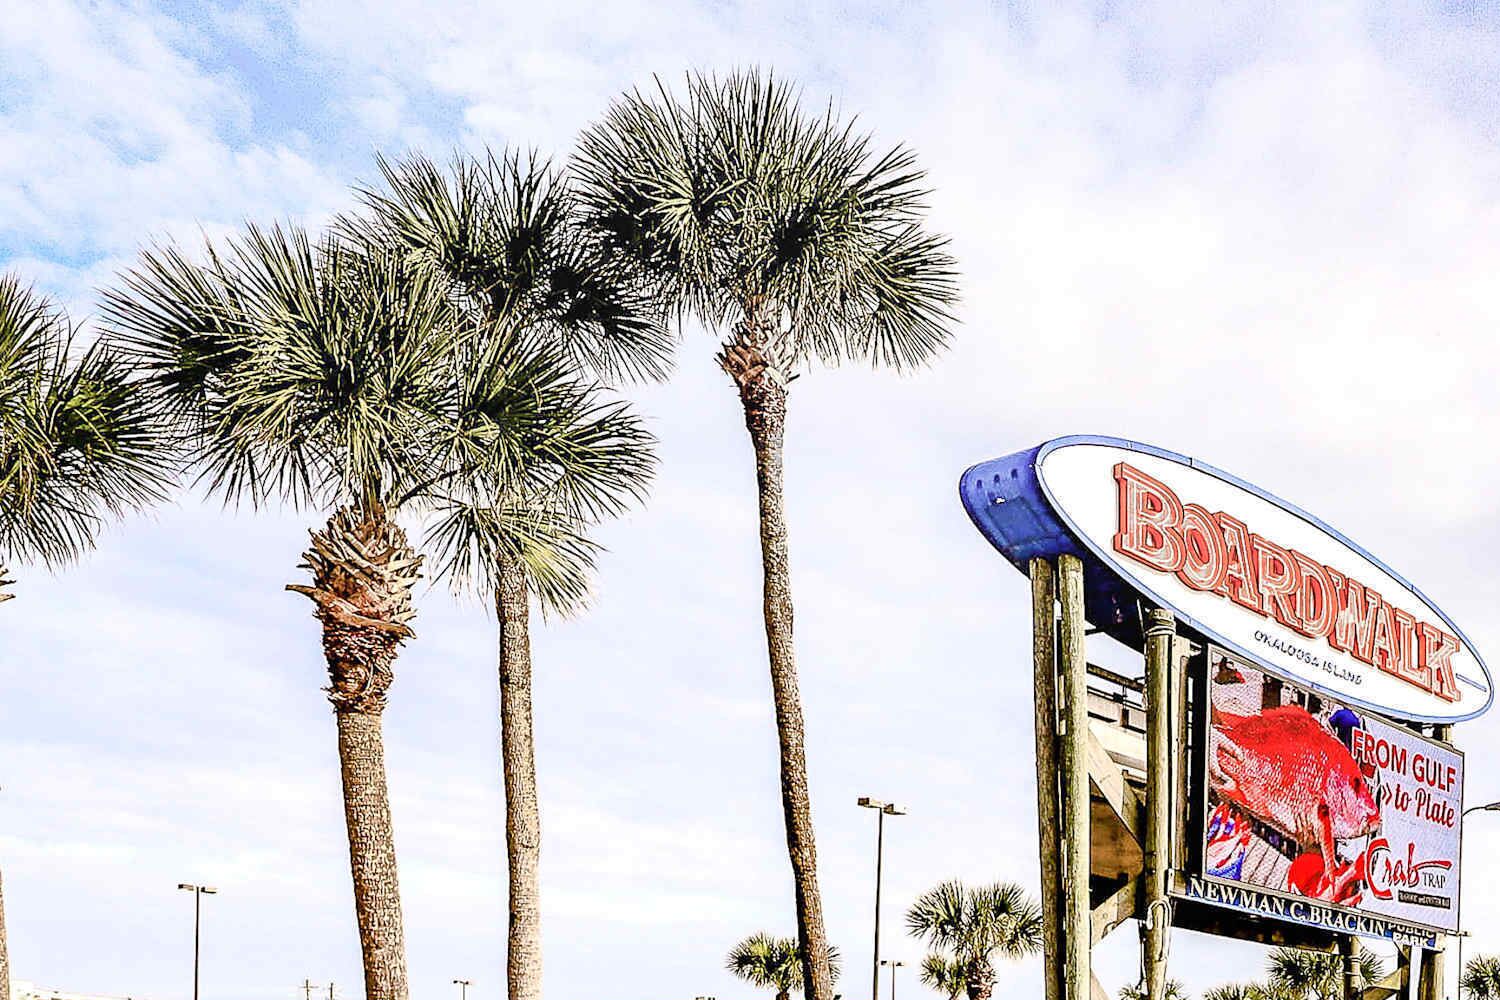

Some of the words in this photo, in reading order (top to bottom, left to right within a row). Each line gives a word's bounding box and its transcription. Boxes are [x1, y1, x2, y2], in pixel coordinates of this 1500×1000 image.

[1112, 461, 1462, 703] BOARDWALK
[1254, 630, 1319, 667] OKALOOSA
[1322, 660, 1362, 685] ISLAND
[1352, 729, 1407, 776] FROM
[1412, 753, 1456, 792] GULF
[1394, 783, 1411, 812] to
[1414, 787, 1455, 828] Plate
[1366, 838, 1452, 900] Crab
[1422, 871, 1447, 889] TRAP
[1189, 877, 1285, 915] NEWMAN
[1289, 901, 1306, 923] C.
[1309, 905, 1386, 937] BRACKIN
[1388, 922, 1435, 938] PUBLIC
[1392, 931, 1429, 948] PARK
